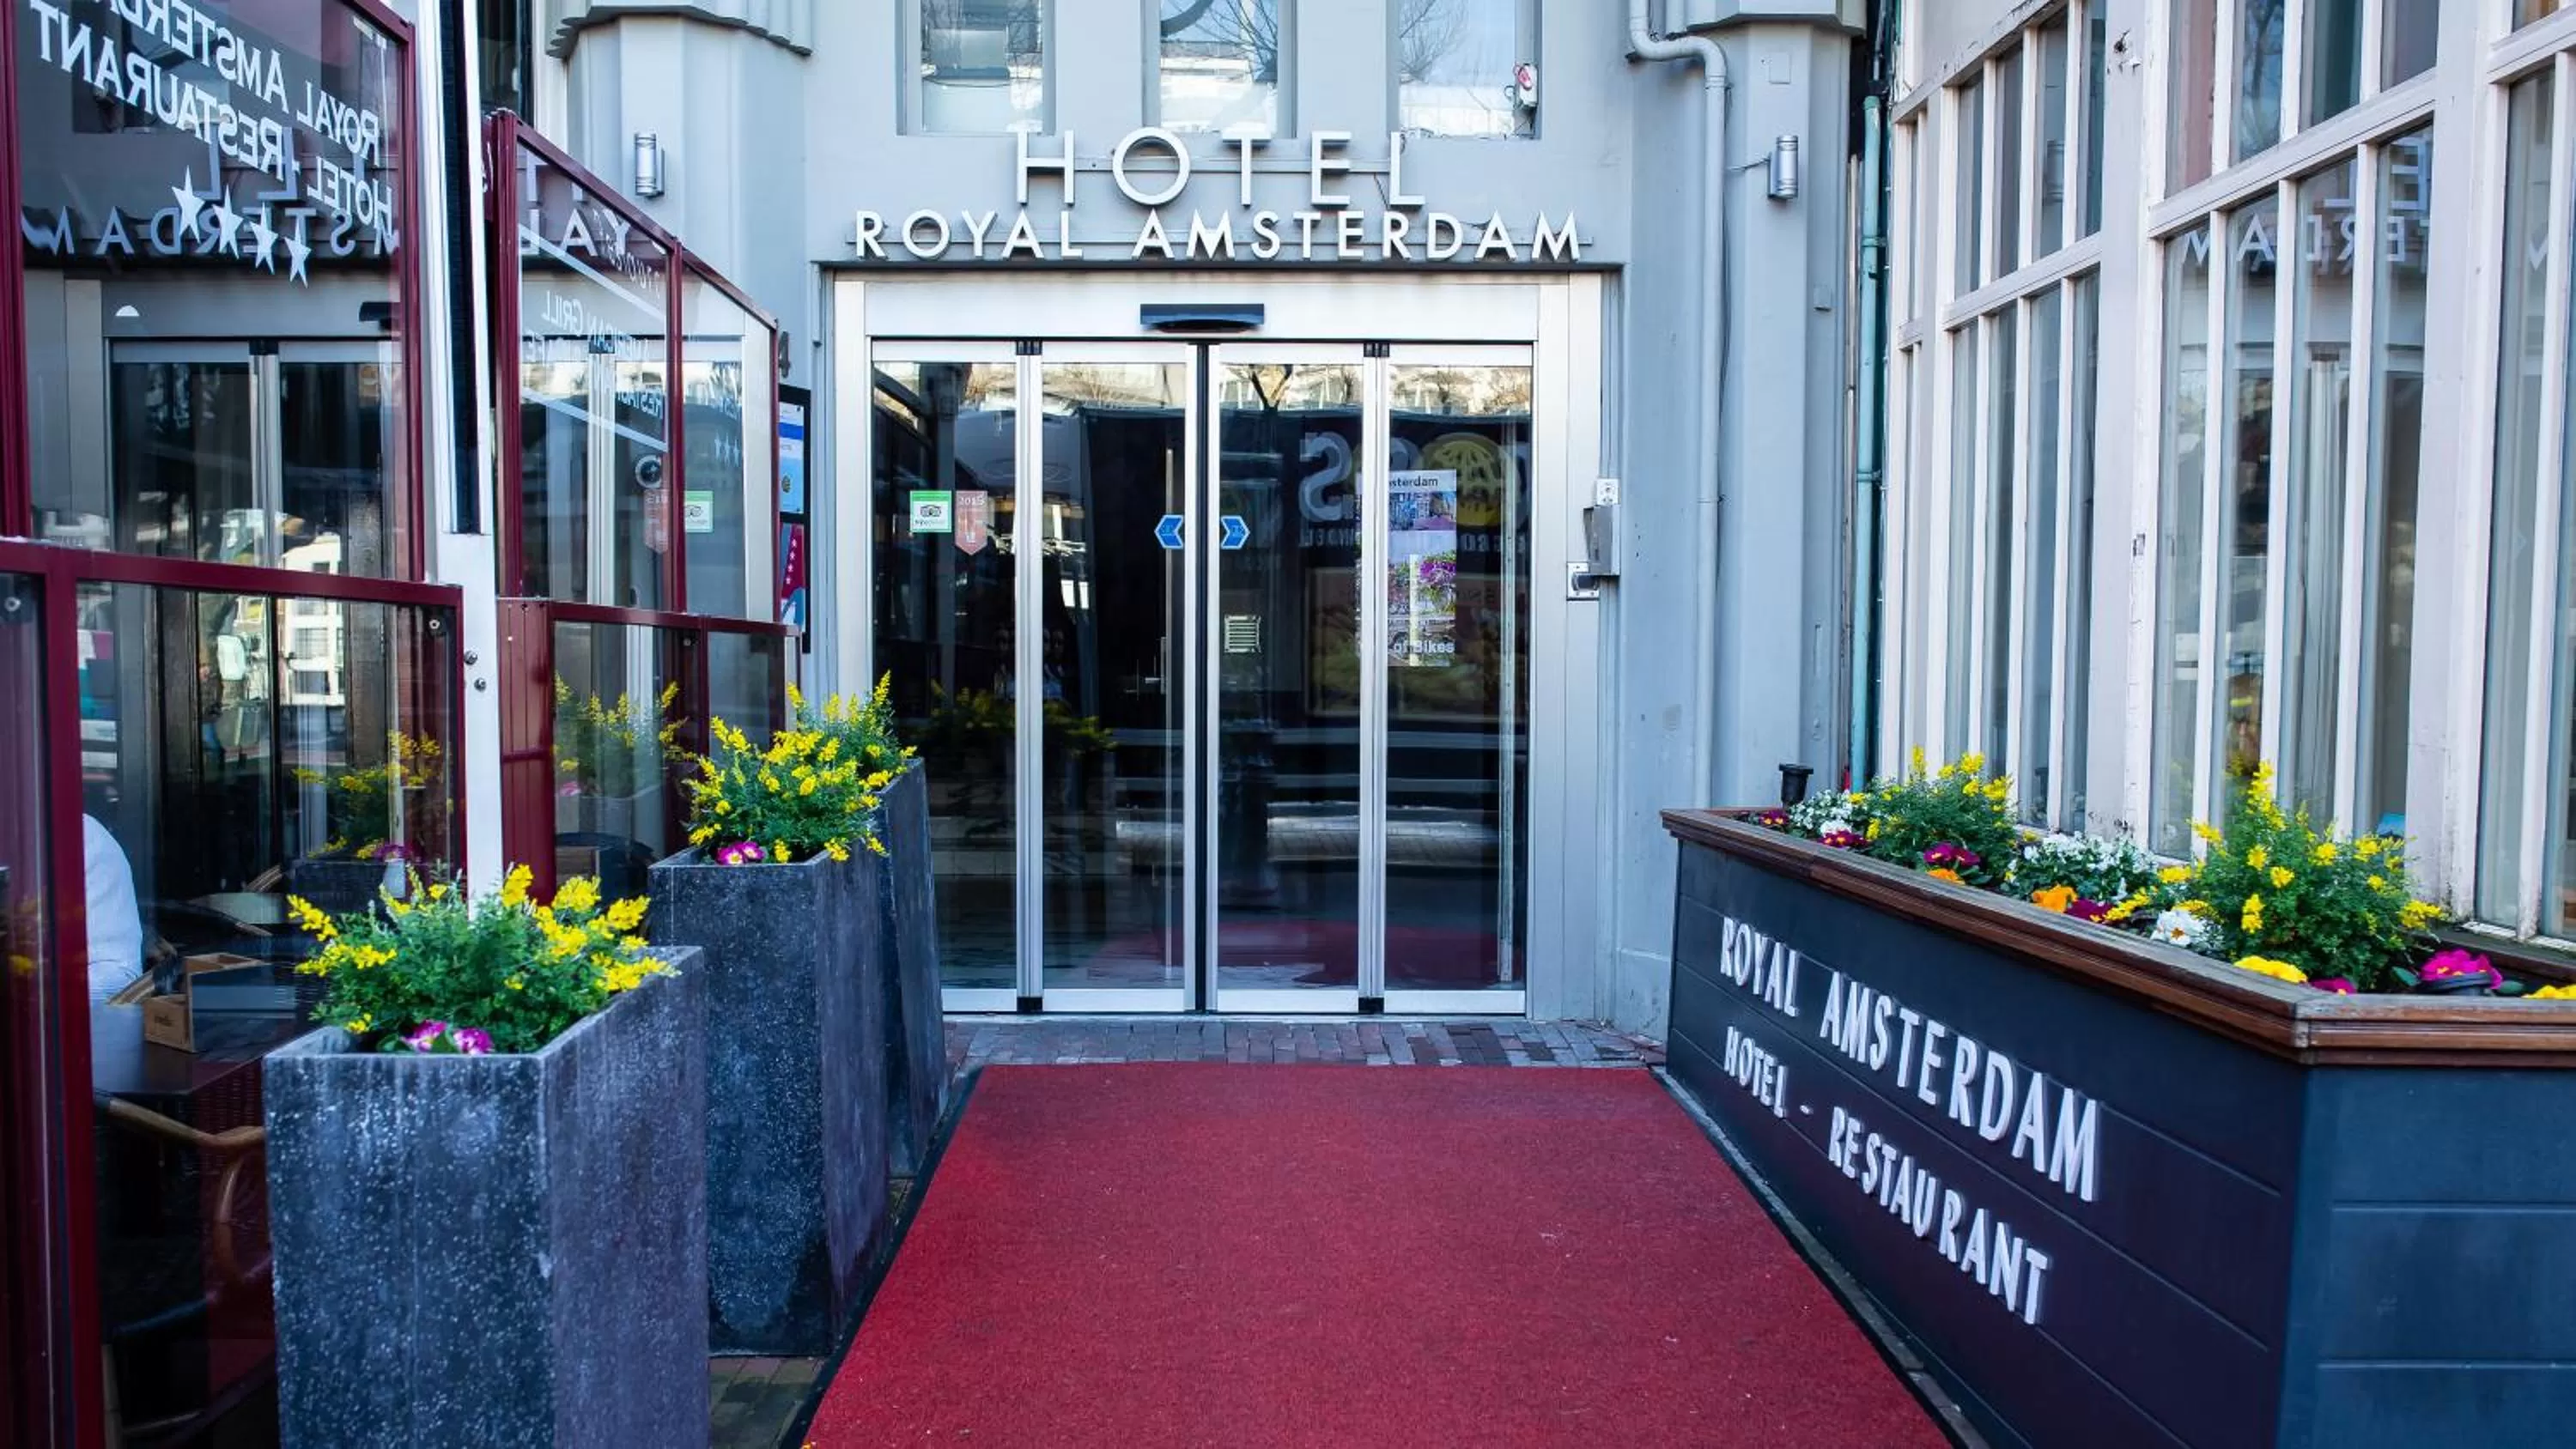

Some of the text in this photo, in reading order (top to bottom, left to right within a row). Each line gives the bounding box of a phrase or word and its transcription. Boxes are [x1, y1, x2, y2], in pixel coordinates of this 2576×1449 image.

[1015, 126, 1426, 208] HOTEL
[856, 209, 1580, 261] ROYAL AMSTERDAM
[1390, 476, 1438, 487] sterdam
[1410, 640, 1455, 653] Bikes
[1720, 916, 2100, 1203] ROYAL AMSTERDAM
[1723, 1026, 1787, 1118] HOTEL
[1828, 1106, 2050, 1325] RESTAURANT
